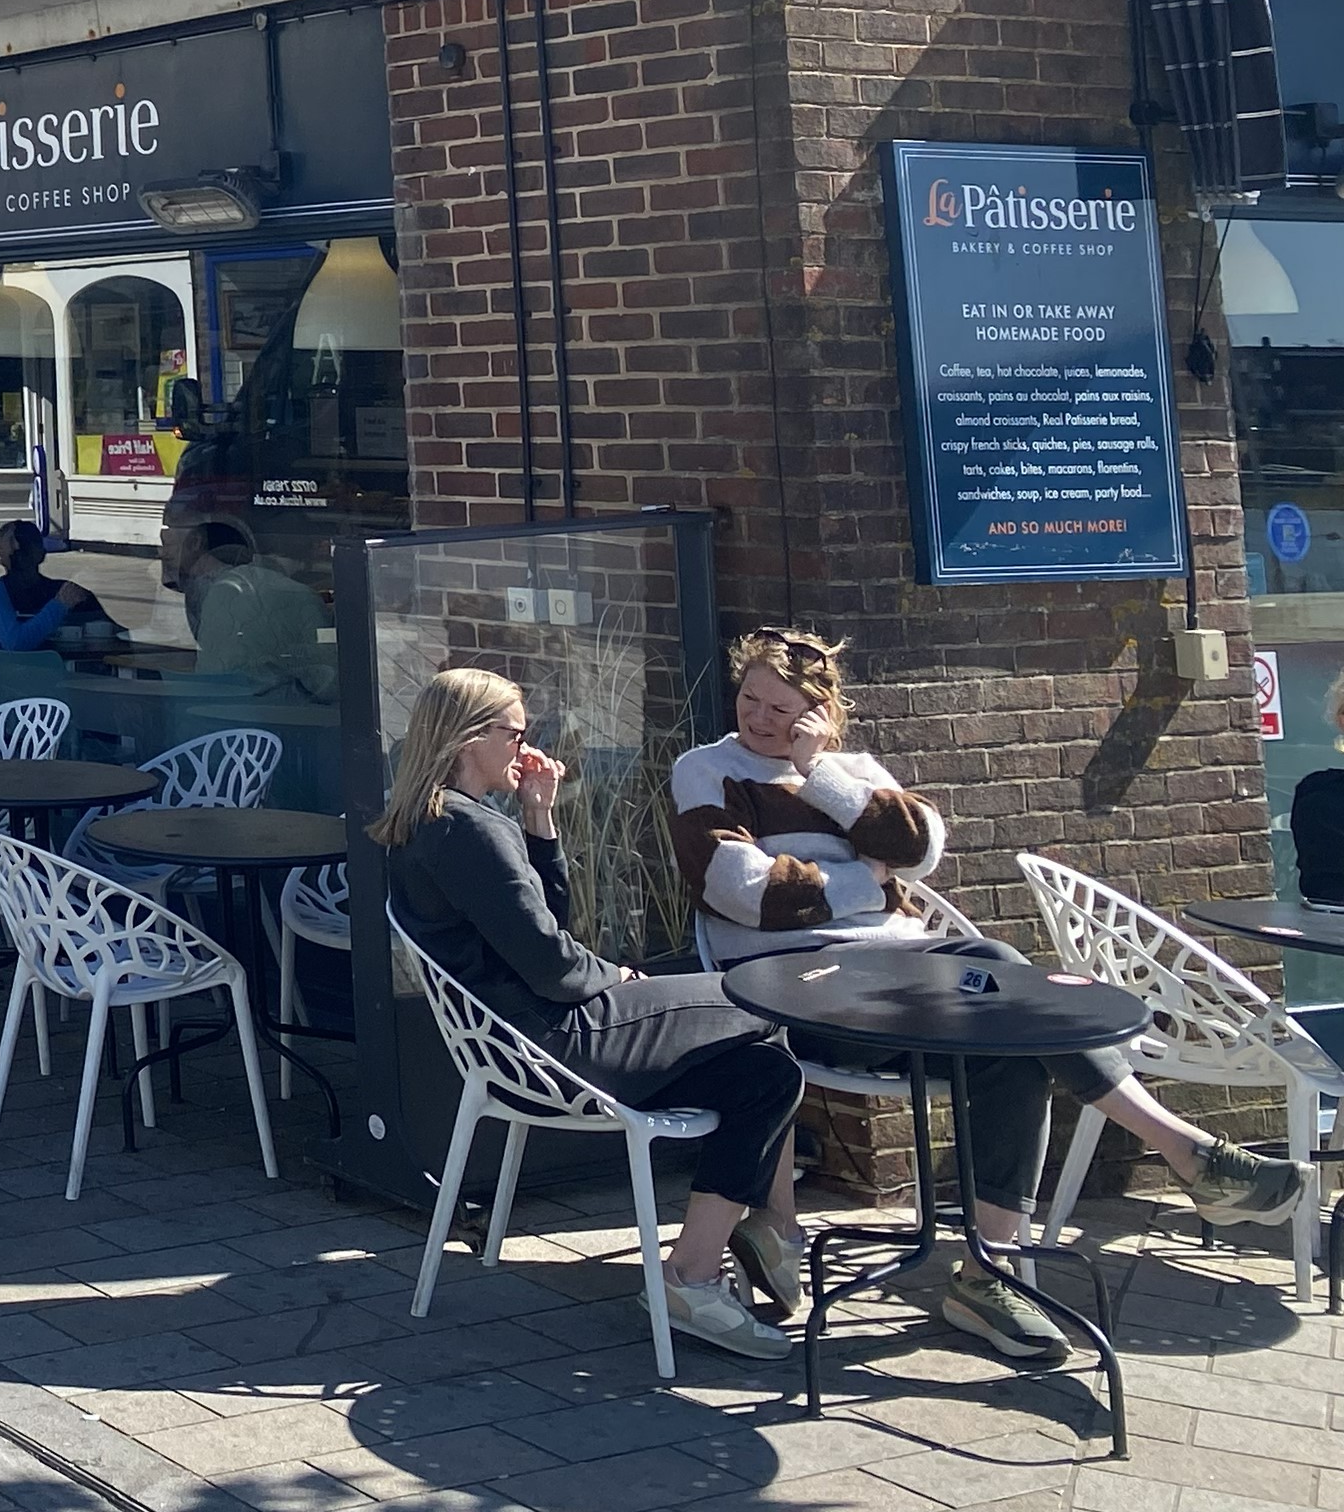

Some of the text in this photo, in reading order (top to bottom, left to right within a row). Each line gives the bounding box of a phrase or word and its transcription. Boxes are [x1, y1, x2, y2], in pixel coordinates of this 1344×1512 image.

[6, 188, 72, 213] COFFEE
[82, 182, 131, 205] SHOP
[923, 179, 1136, 232] La Pâtisserie
[952, 241, 1114, 256] BAKERY & COFFEE SHOP
[962, 304, 1116, 320] EAT IN OR TAKE AWAY
[976, 326, 1106, 342] HOMEMADE FOOD
[939, 364, 1148, 381] Coffee, tea, hot chocolate, juices, lemonades,
[937, 388, 1154, 405] croissants, pains au chocolat, pains aux raisins,
[955, 412, 1141, 428] almond croissants, Real Patisserie bread,
[941, 436, 1159, 455] crispy french sticks, quiches, pies, sausage rolls,
[963, 460, 1142, 477] tarts, cakes, bites, macarons, florentins,
[957, 486, 1015, 502] sandwiches,
[1017, 489, 1043, 503] soup,
[1044, 487, 1059, 499] ice
[1061, 489, 1093, 501] cream,
[1095, 487, 1119, 502] party
[988, 519, 1128, 535] AND SO MUCH MORE!
[963, 971, 983, 988] 26
